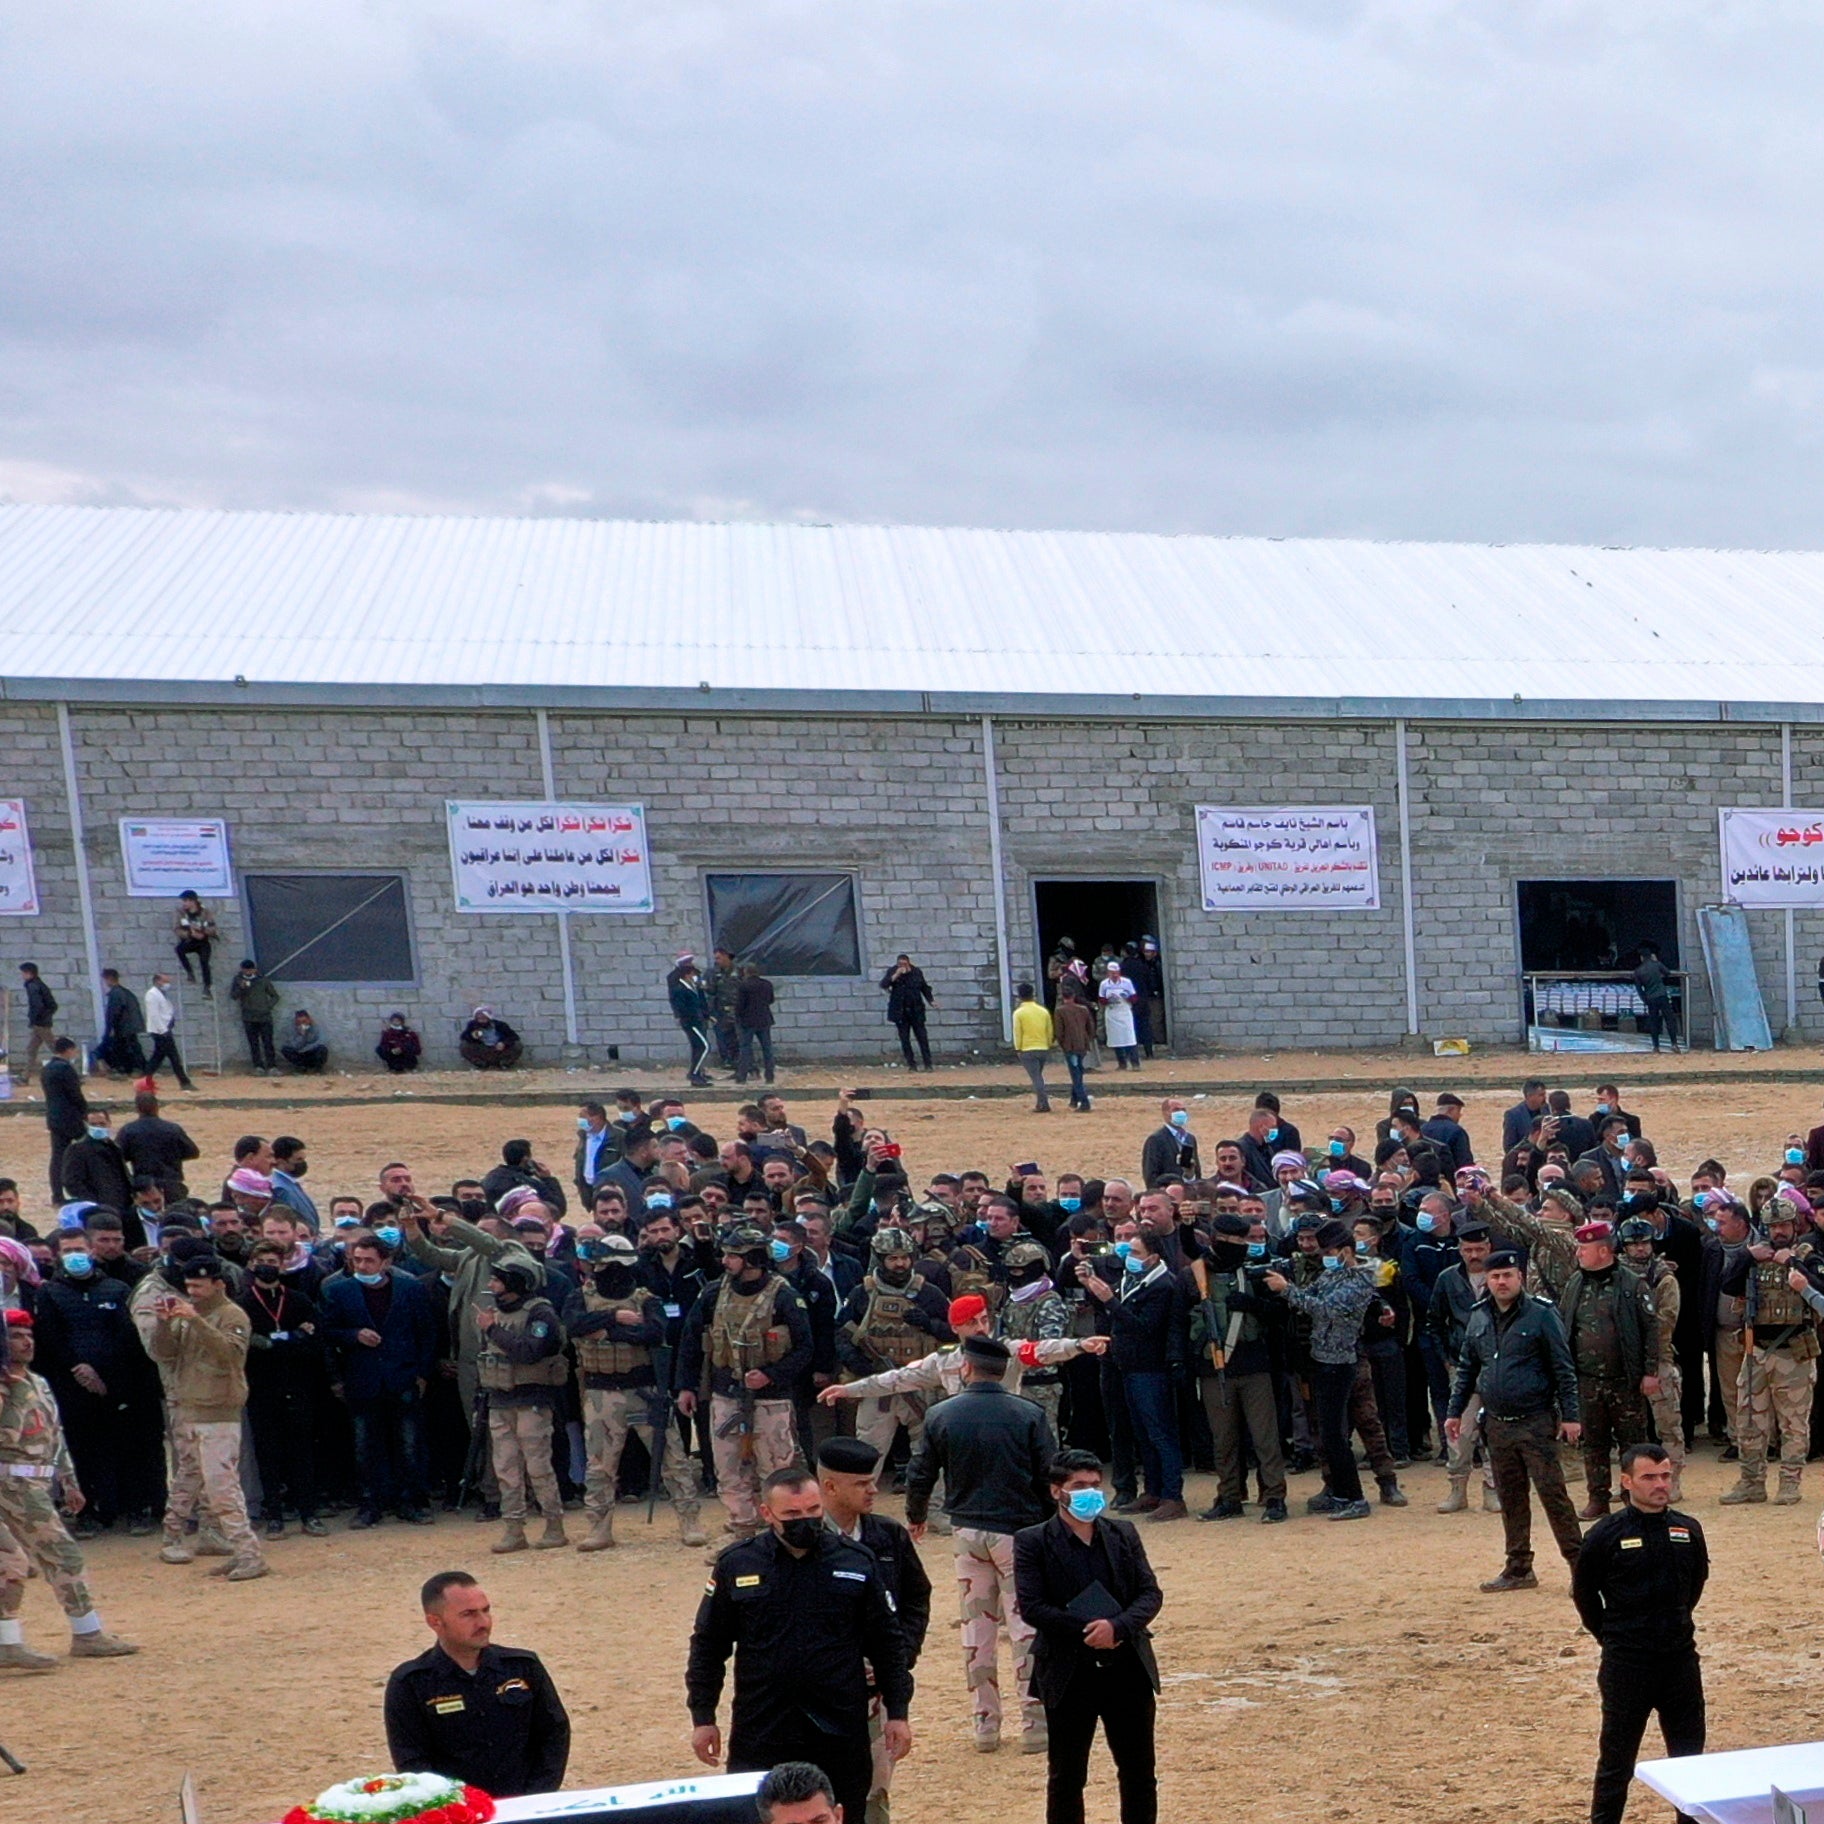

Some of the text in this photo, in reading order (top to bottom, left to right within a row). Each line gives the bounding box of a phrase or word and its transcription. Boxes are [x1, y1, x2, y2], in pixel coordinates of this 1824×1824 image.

[517, 819, 533, 833] من
[536, 816, 554, 833] لكل
[556, 816, 580, 834] شكرا
[583, 816, 607, 834] شكرا
[608, 816, 632, 834] شكرا
[1221, 817, 1245, 829] قاسم
[1246, 819, 1272, 830] جاسم
[1274, 817, 1297, 830] نايف
[1298, 816, 1324, 832] الشيخ
[1775, 822, 1824, 847] كوجو
[1254, 838, 1282, 851] كوجو
[1284, 838, 1306, 851] قرية
[460, 847, 501, 866] عراقيون
[544, 847, 575, 863] عاملنا
[577, 851, 593, 866] من
[595, 847, 613, 865] لكل
[616, 848, 640, 865] شكرا
[1730, 865, 1770, 885] عائدين
[1772, 865, 1819, 885] ولترابها
[487, 880, 519, 897] العراق
[520, 882, 535, 896] هو
[537, 880, 561, 897] واحد
[562, 880, 585, 897] وطن
